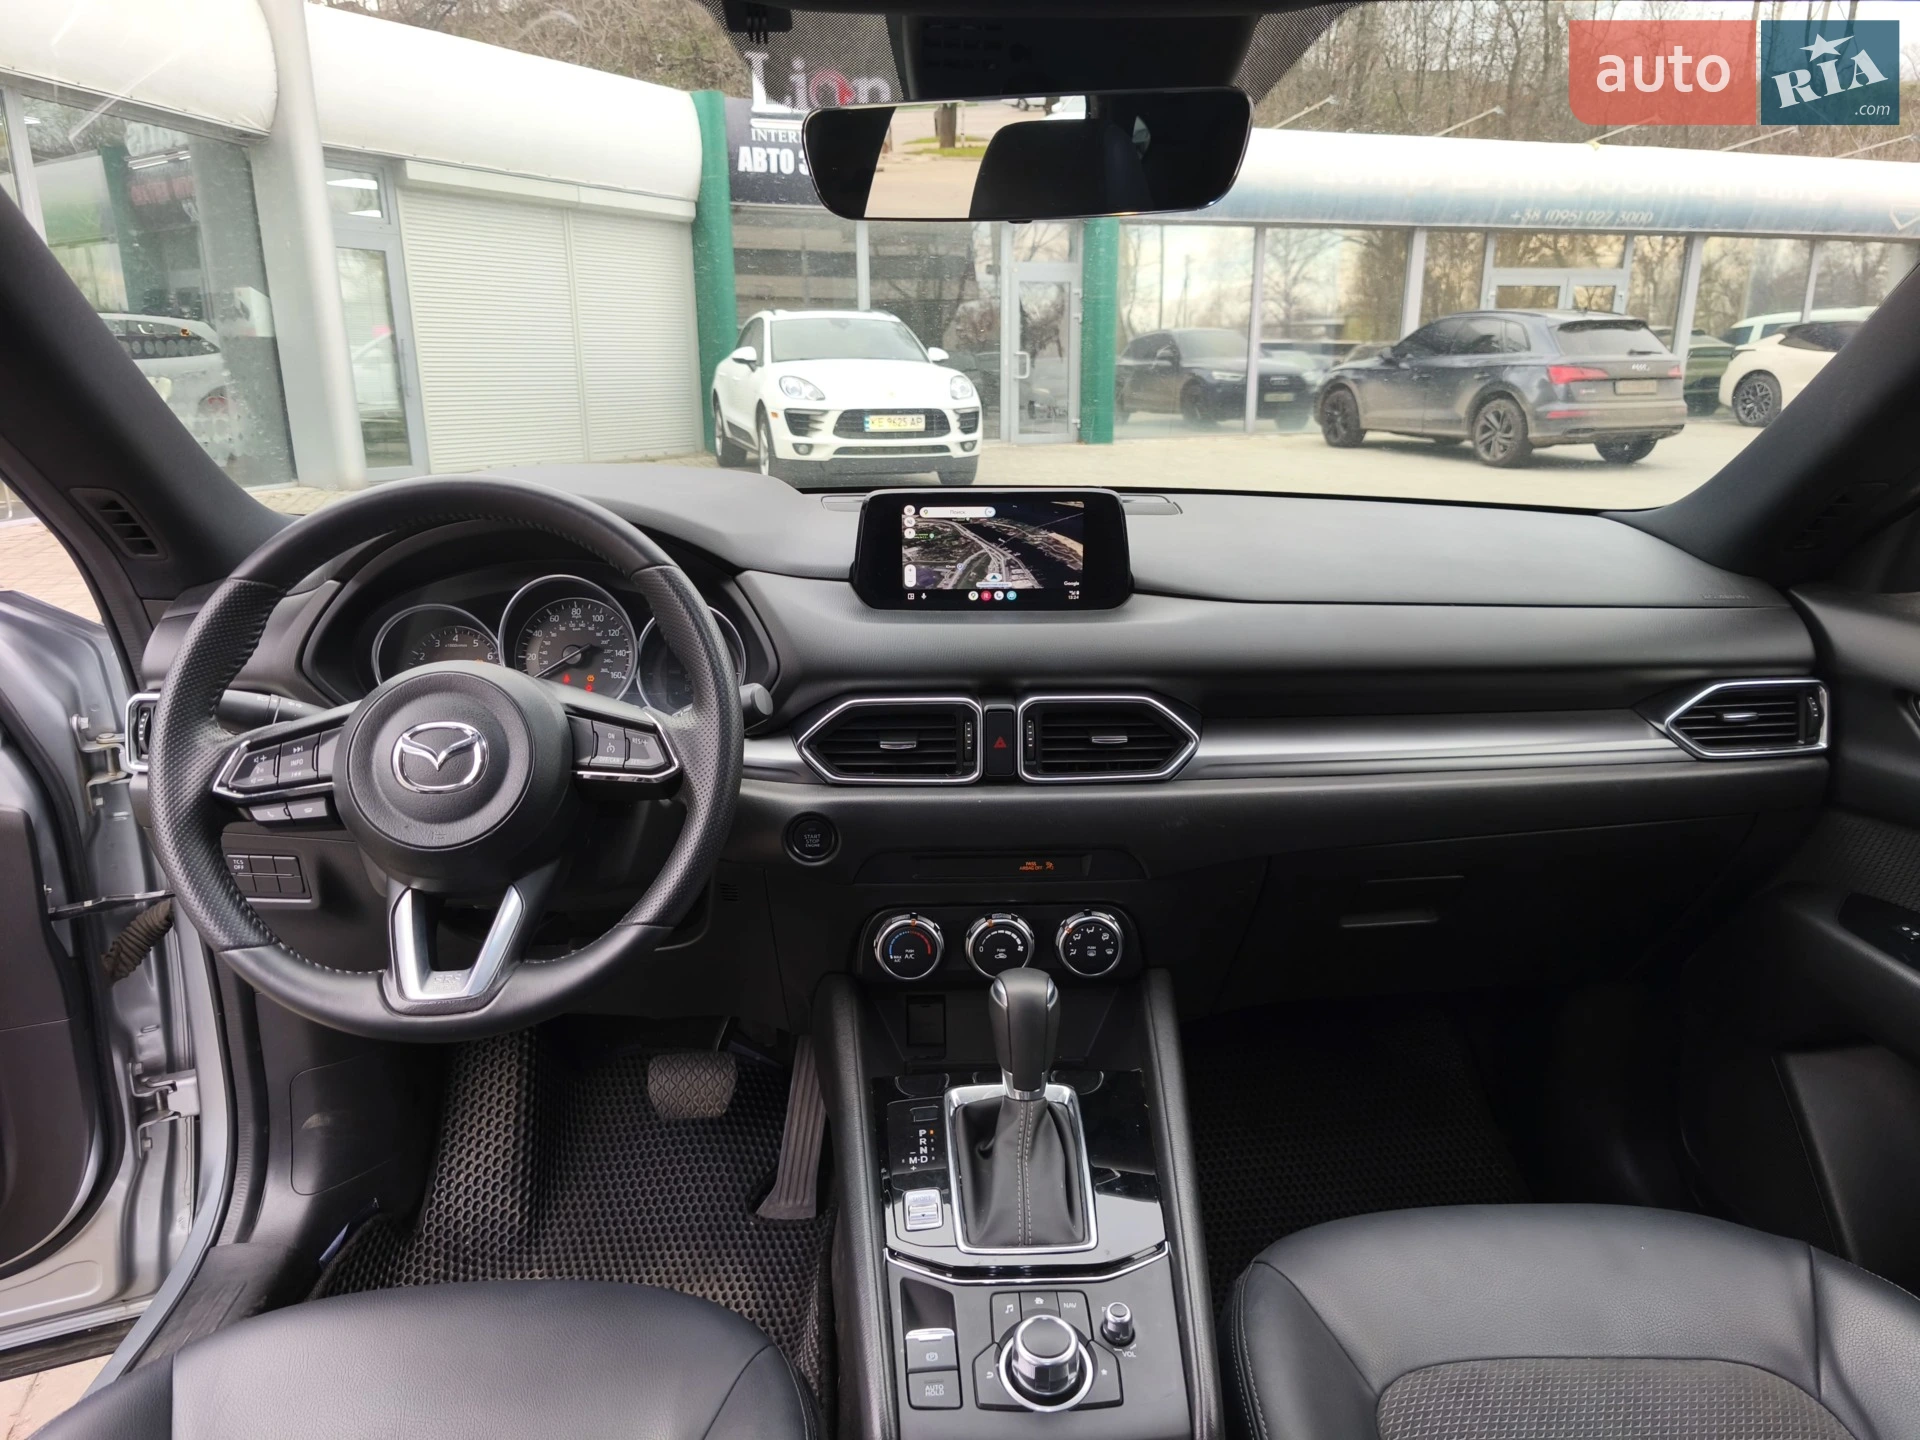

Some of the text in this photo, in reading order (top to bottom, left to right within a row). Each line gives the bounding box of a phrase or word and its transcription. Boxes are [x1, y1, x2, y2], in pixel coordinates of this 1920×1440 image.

[750, 128, 802, 143] INTER
[738, 146, 794, 174] АВТО
[1511, 208, 1653, 224] +38 (095) 027 3000
[453, 634, 458, 642] 4
[920, 1146, 928, 1154] N
